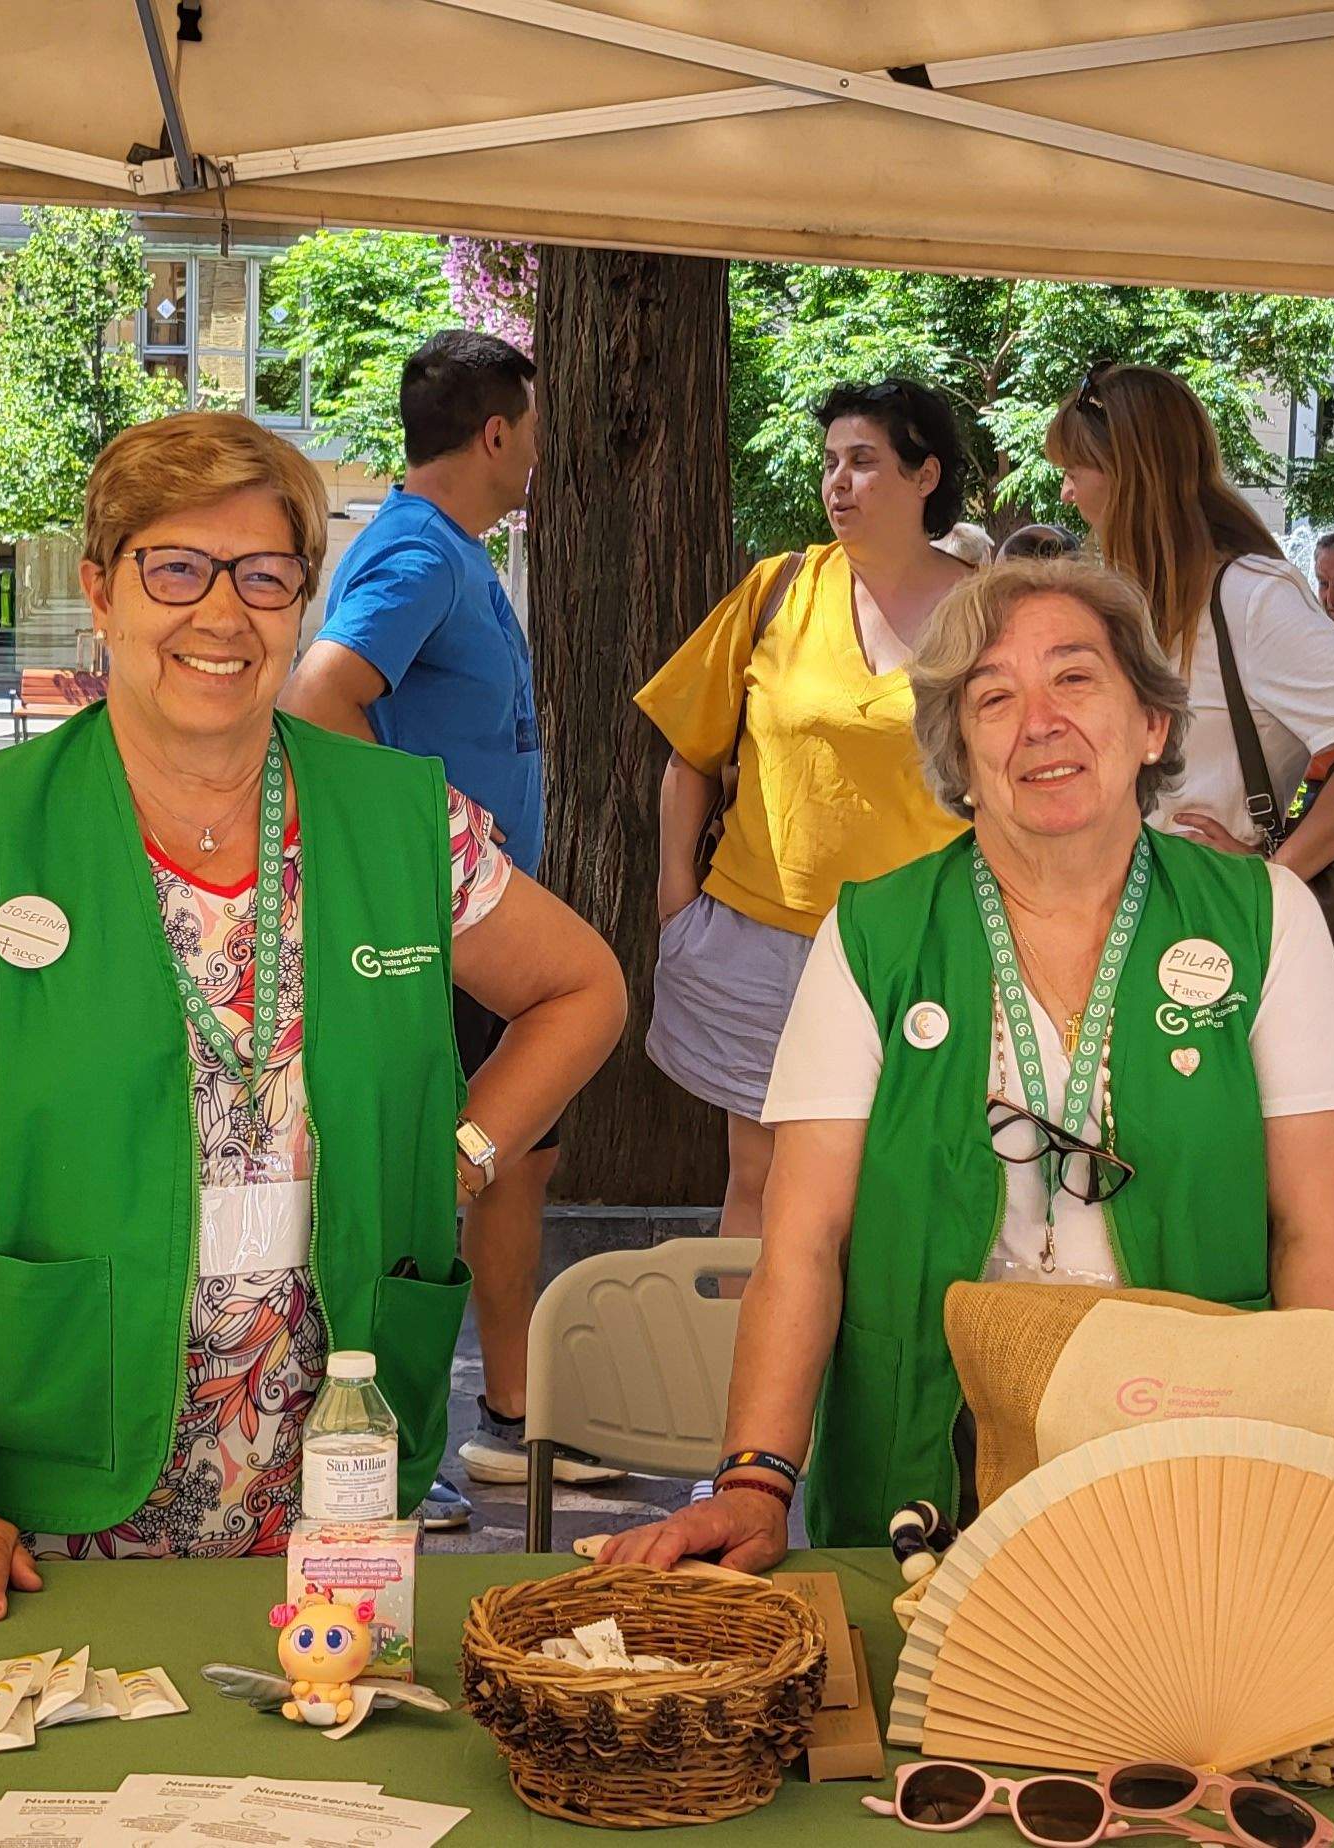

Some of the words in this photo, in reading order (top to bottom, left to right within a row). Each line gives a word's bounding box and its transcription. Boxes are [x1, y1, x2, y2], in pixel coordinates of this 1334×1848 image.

[2, 905, 67, 932] JOSEFINA
[12, 947, 45, 964] aecc
[1168, 948, 1230, 974] PILAR
[1181, 986, 1213, 1000] aecc
[326, 1458, 350, 1473] San
[352, 1457, 387, 1473] Millán
[165, 1779, 235, 1790] Nuestros
[24, 1797, 97, 1805] Nuestros
[252, 1785, 320, 1801] Nuestros
[321, 1797, 385, 1812] servicios
